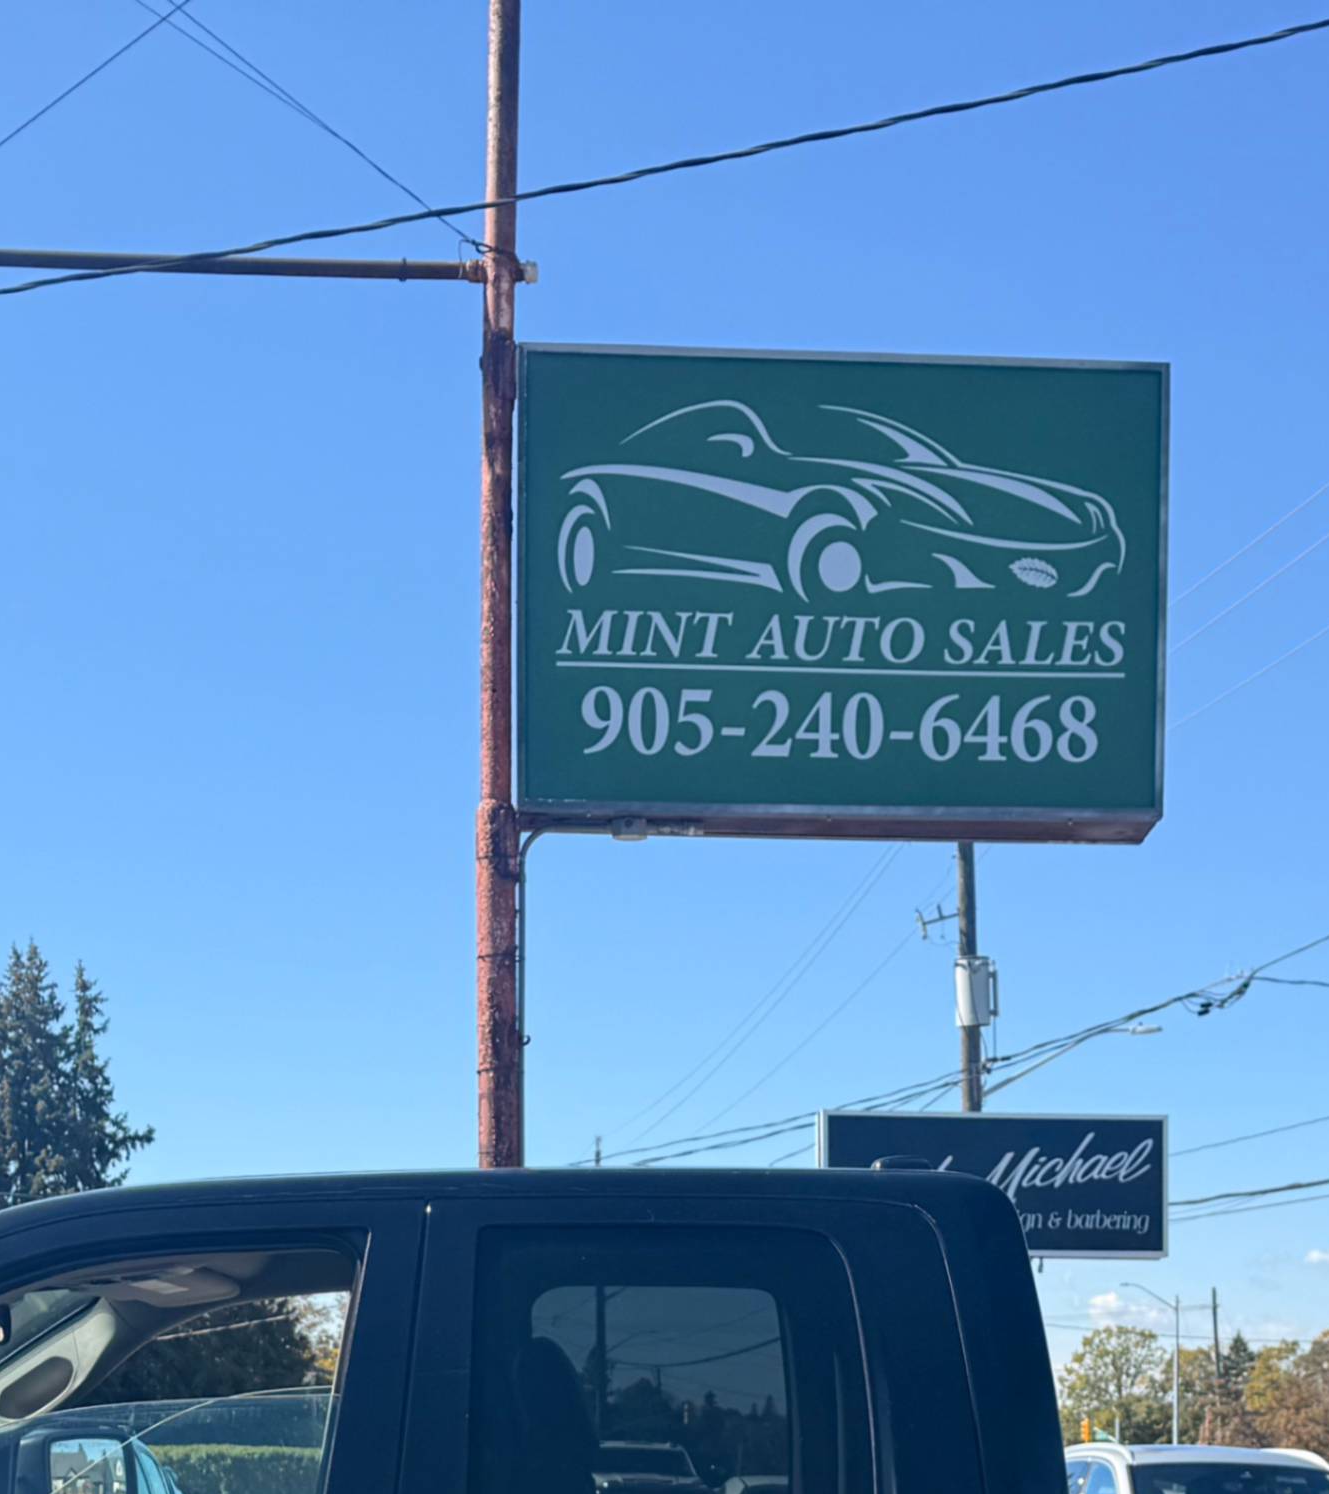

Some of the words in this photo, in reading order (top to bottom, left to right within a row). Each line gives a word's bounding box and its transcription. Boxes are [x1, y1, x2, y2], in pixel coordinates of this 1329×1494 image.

[555, 609, 734, 658] MINT
[746, 613, 926, 664] AUTO
[943, 618, 1127, 667] SALES
[580, 684, 1100, 763] 905-240-6468
[985, 1131, 1154, 1204] Michael
[1047, 1211, 1063, 1230] &
[1066, 1208, 1150, 1235] barbering
